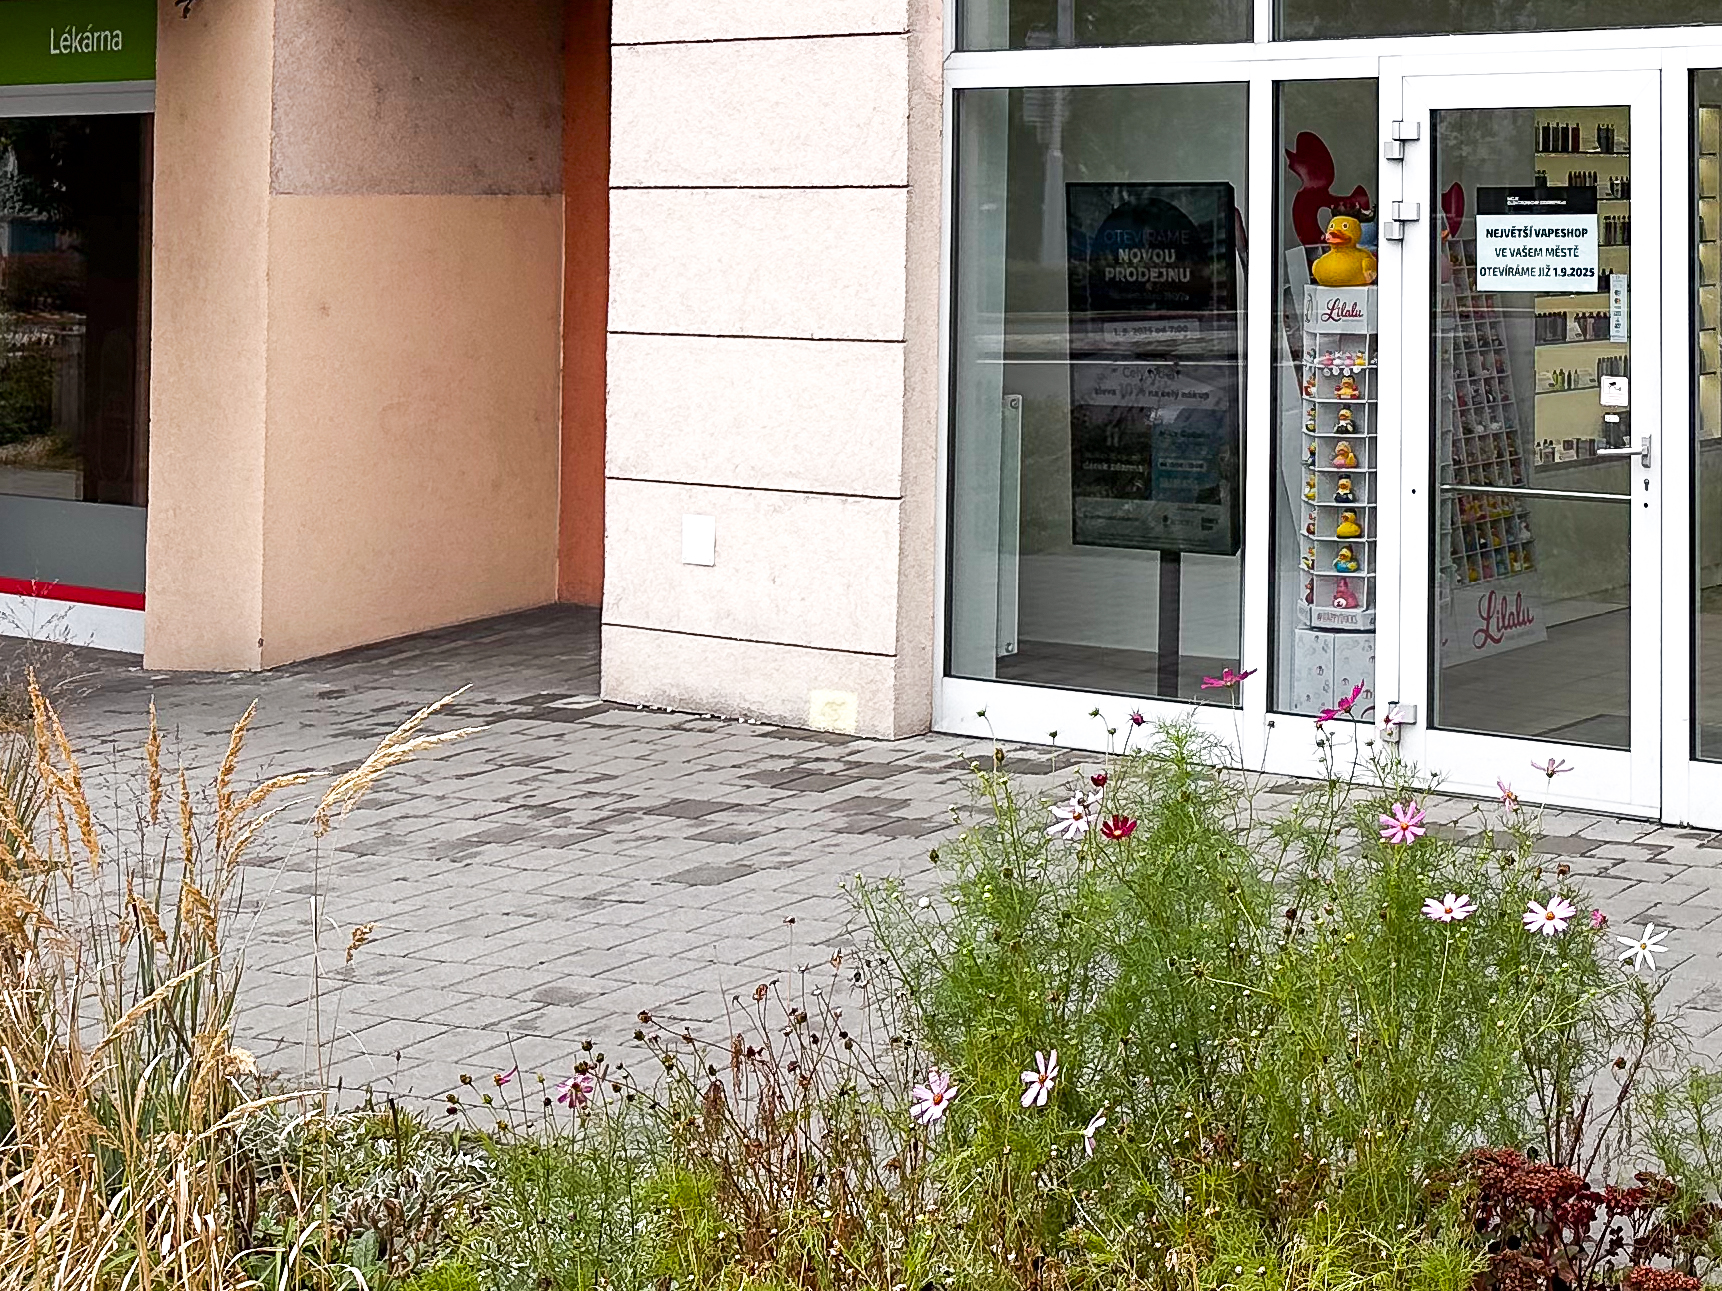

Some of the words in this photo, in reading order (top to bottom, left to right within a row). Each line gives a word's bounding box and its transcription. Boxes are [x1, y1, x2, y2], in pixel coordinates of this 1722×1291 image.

[50, 23, 122, 55] Lékárna
[1485, 225, 1533, 239] NEJVĚTŠÍ
[1534, 227, 1589, 239] VAPESHOP
[1117, 248, 1176, 264] NOVOU
[1494, 247, 1508, 258] VE
[1510, 245, 1543, 258] VAŠEM
[1545, 245, 1580, 258] MĚSTĚ
[1104, 267, 1192, 283] PRODEJNU
[1479, 264, 1537, 278] OTEVÍRÁME
[1538, 264, 1551, 278] JIŽ
[1552, 266, 1596, 278] 1.9.2025
[1320, 297, 1364, 322] Lilalu
[1472, 589, 1535, 650] Lilalu
